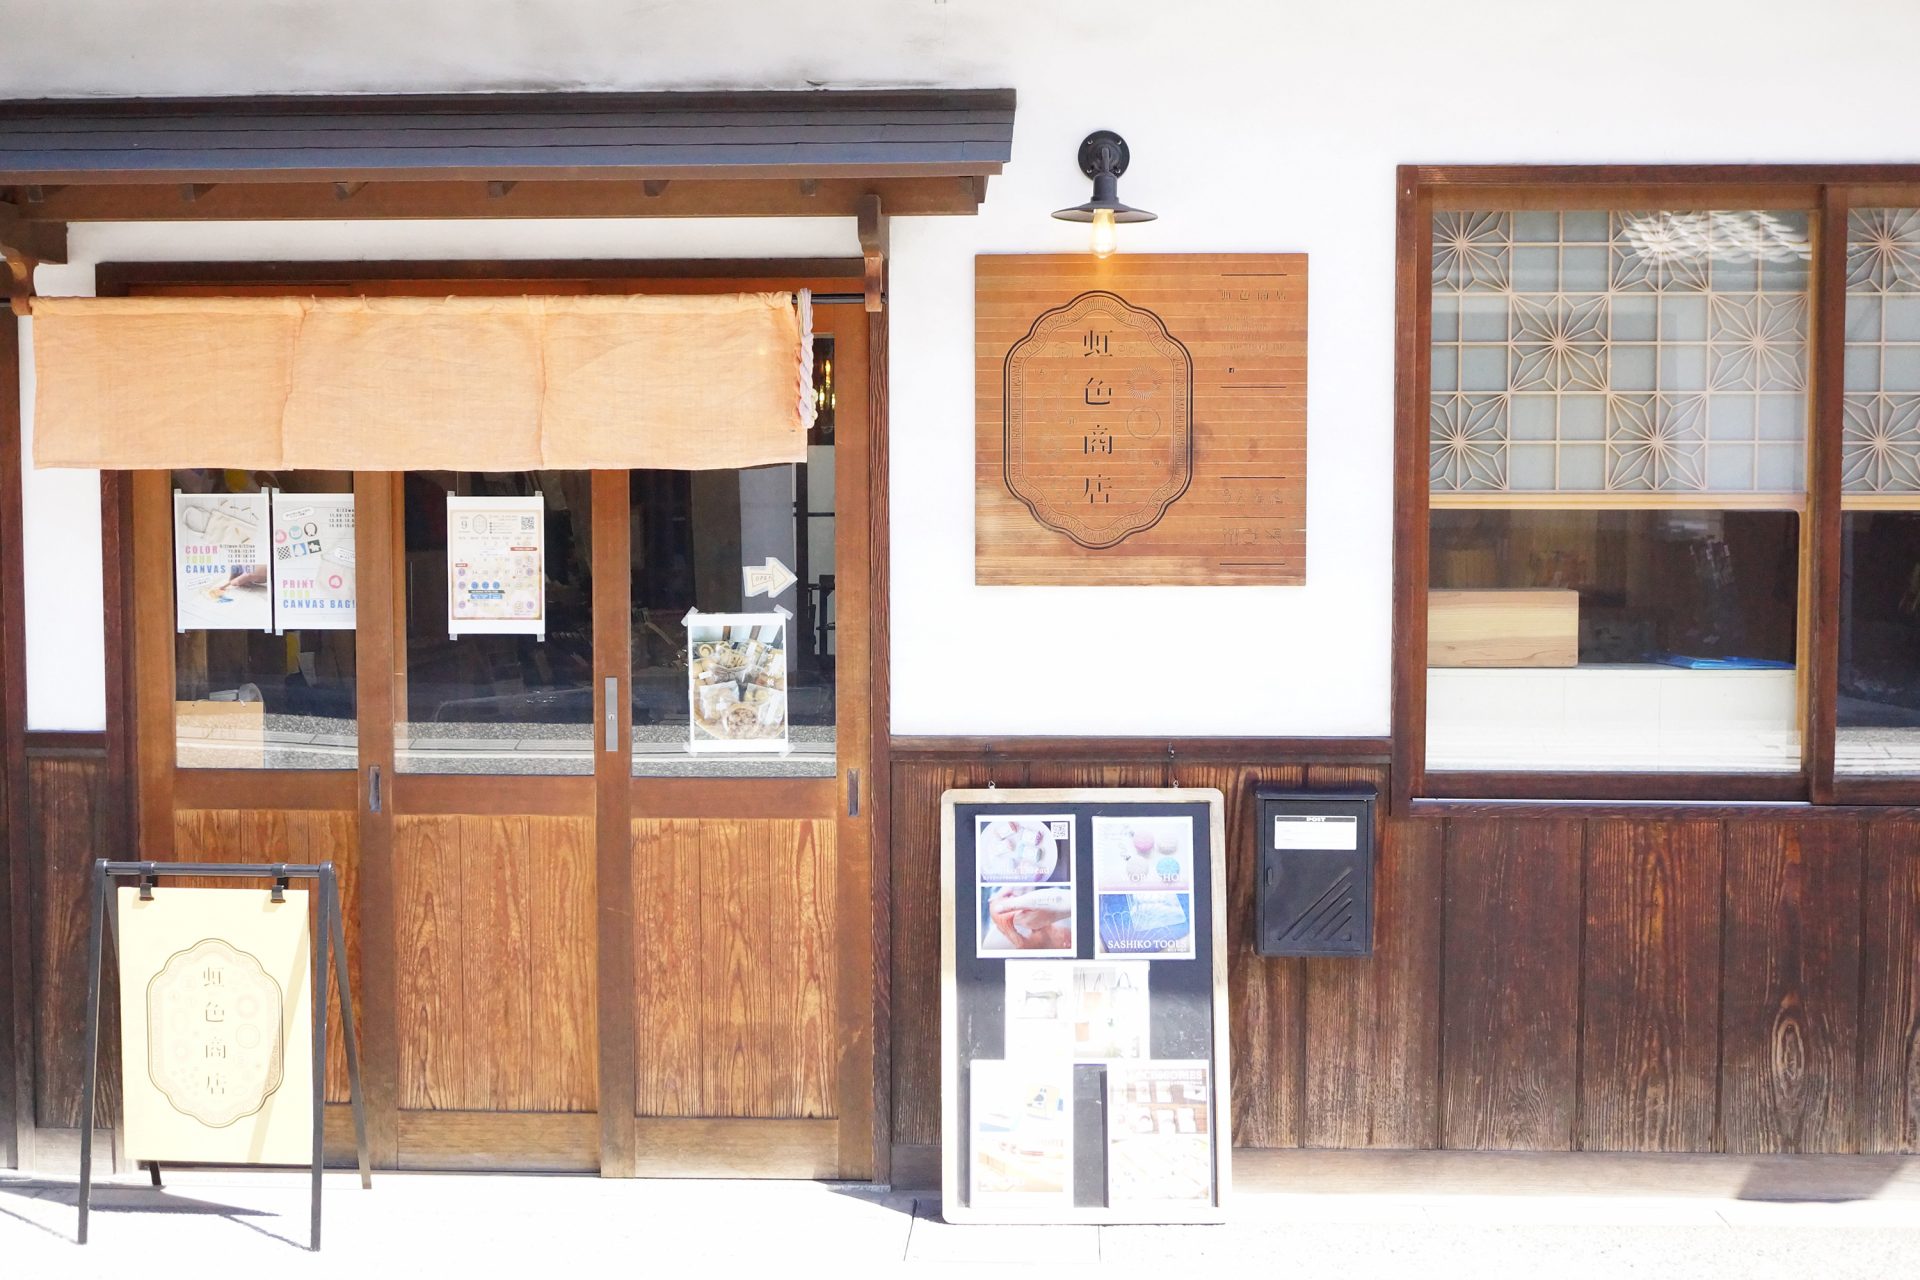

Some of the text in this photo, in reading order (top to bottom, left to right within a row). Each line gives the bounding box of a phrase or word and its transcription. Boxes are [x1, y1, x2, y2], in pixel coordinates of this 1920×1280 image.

[185, 545, 218, 554] COLOR
[185, 564, 256, 574] CANVAS BAG!
[282, 579, 315, 589] PRINT
[283, 599, 325, 609] CANVAS
[1107, 939, 1187, 949] SASHIKO TOOLS
